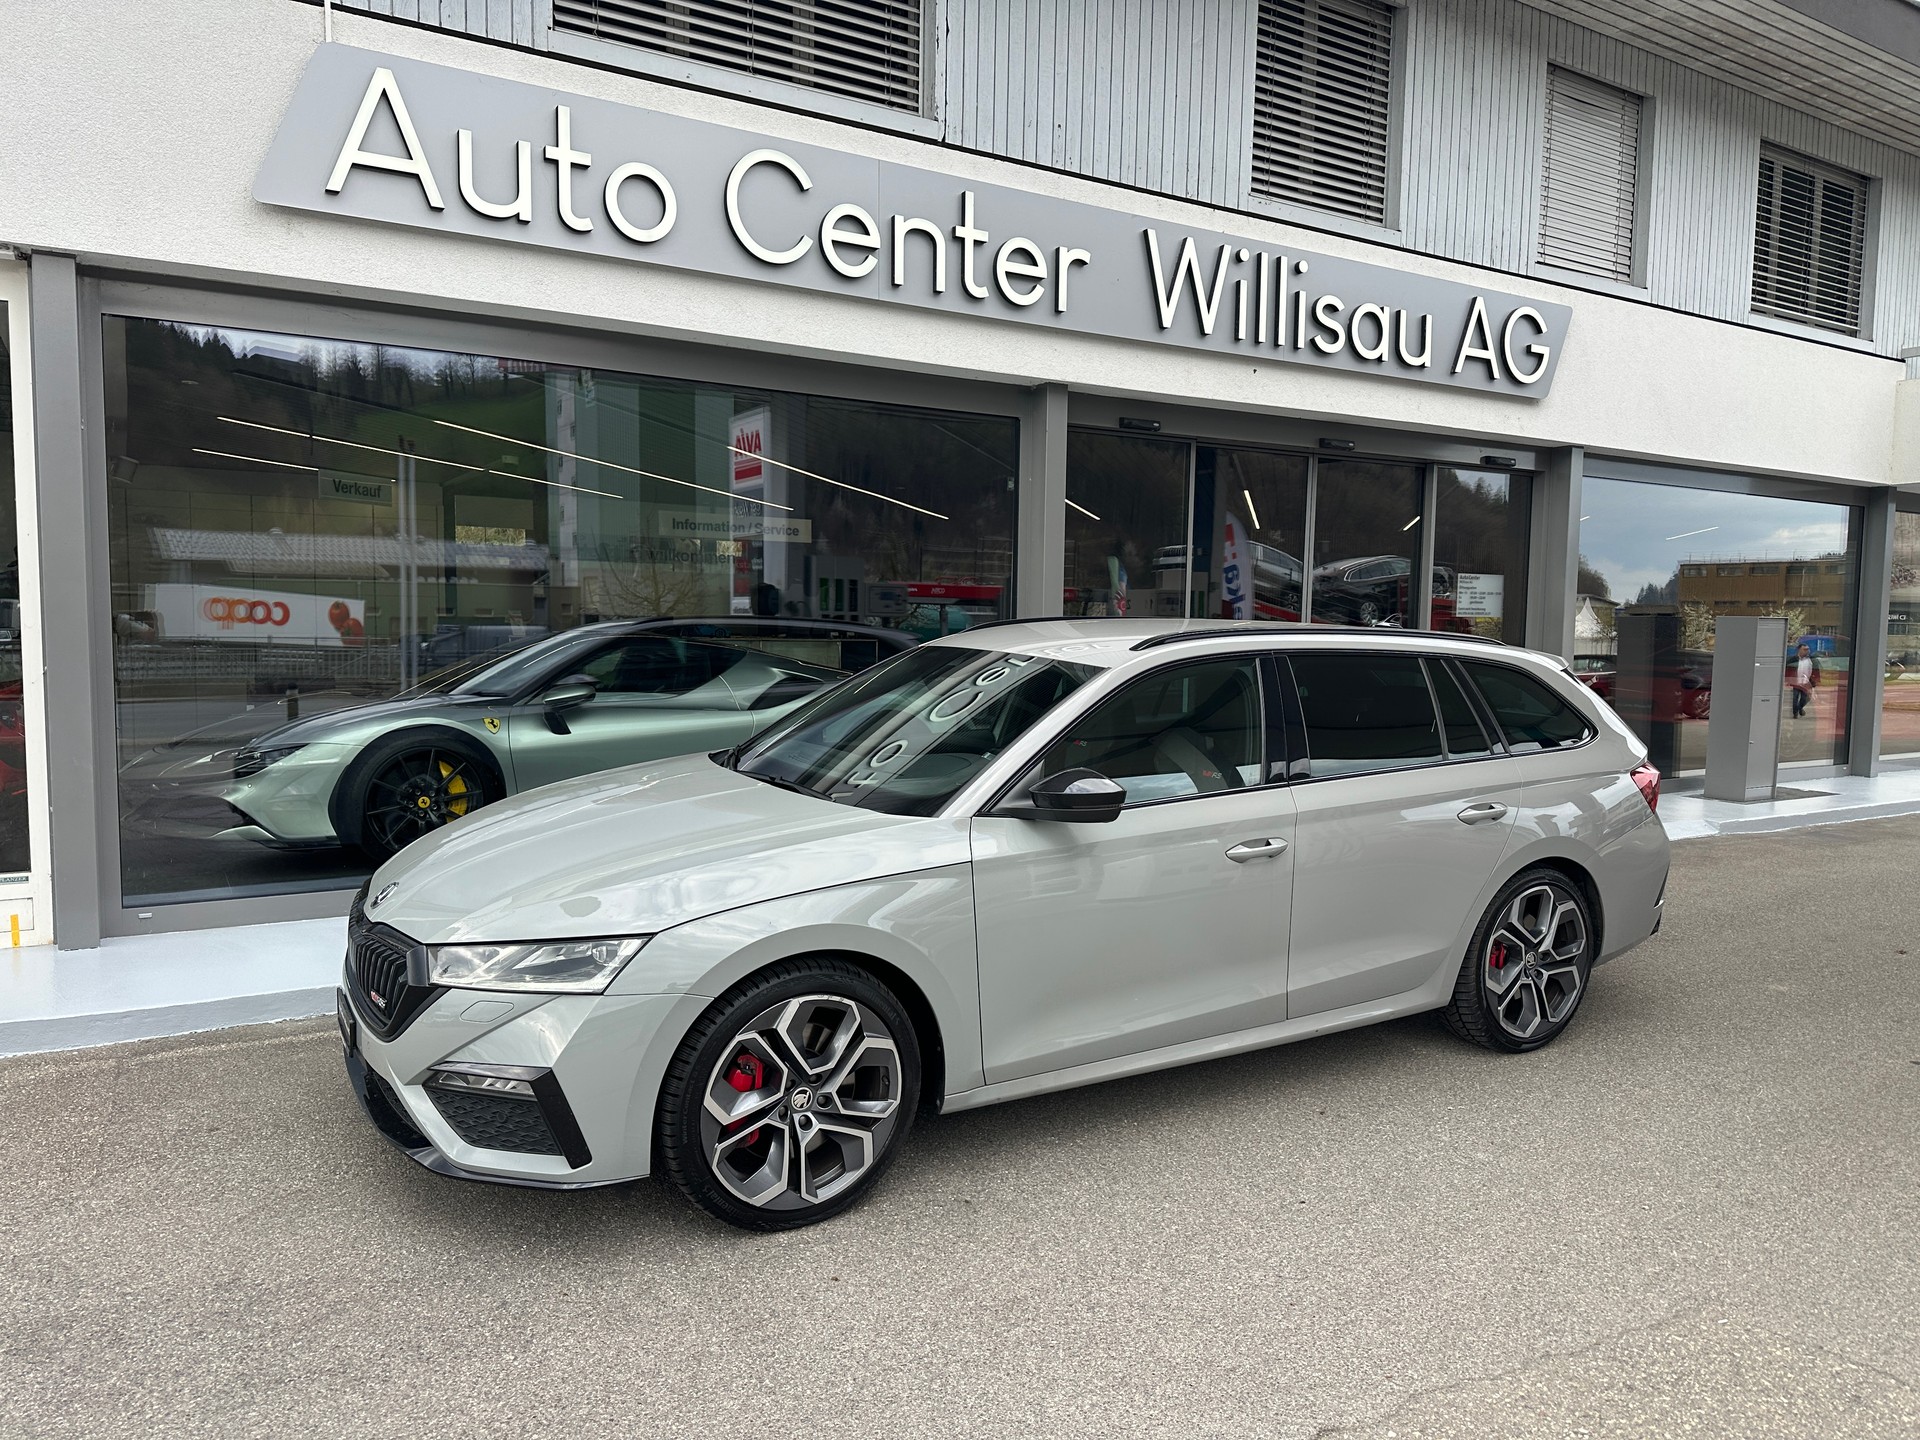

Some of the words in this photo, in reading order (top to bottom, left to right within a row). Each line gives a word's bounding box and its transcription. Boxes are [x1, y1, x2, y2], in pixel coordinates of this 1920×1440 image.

[325, 67, 678, 243] Auto
[725, 149, 1091, 313] Center
[1143, 228, 1433, 367] Willisau
[1454, 296, 1551, 384] AG
[332, 478, 382, 498] Verkauf
[672, 517, 745, 534] Information
[755, 523, 800, 537] Service
